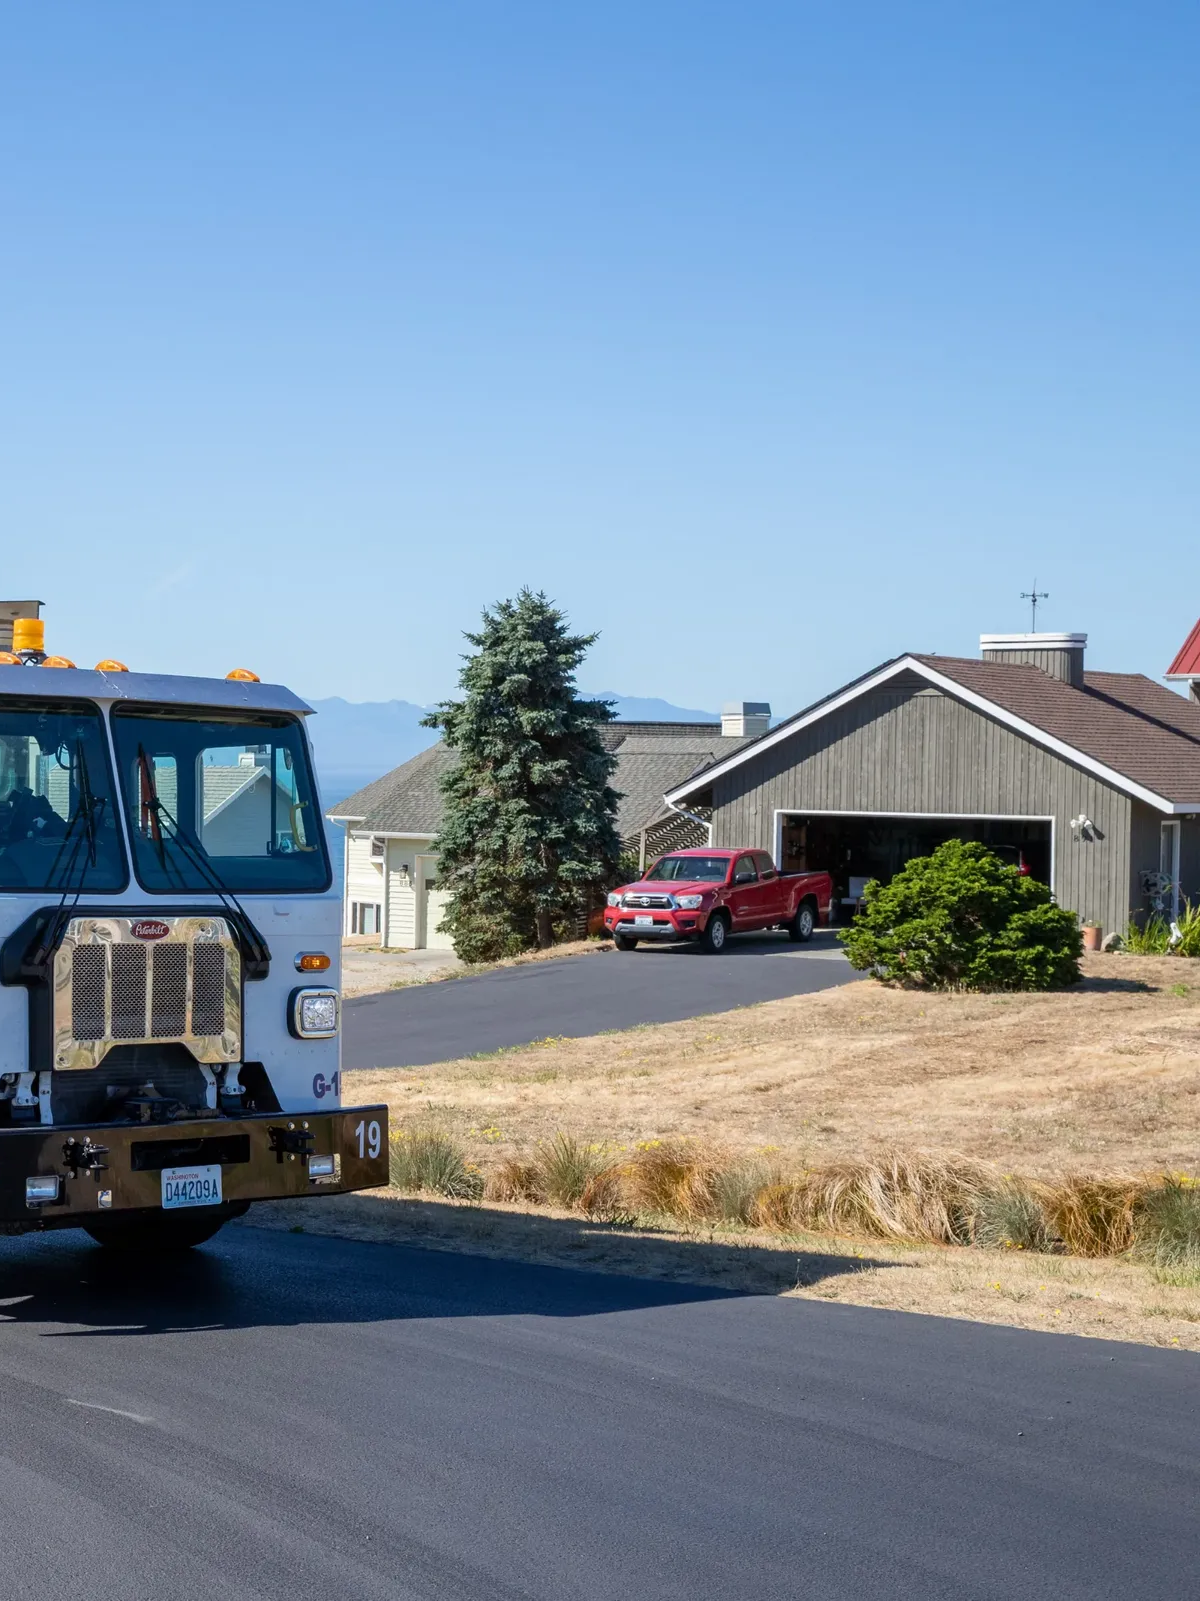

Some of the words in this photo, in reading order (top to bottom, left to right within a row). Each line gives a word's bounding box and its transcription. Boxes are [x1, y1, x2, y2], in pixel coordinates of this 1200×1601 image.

[135, 923, 167, 936] Peterbilt
[312, 1071, 341, 1099] G-1
[355, 1120, 381, 1159] 19
[165, 1178, 219, 1202] D44209A
